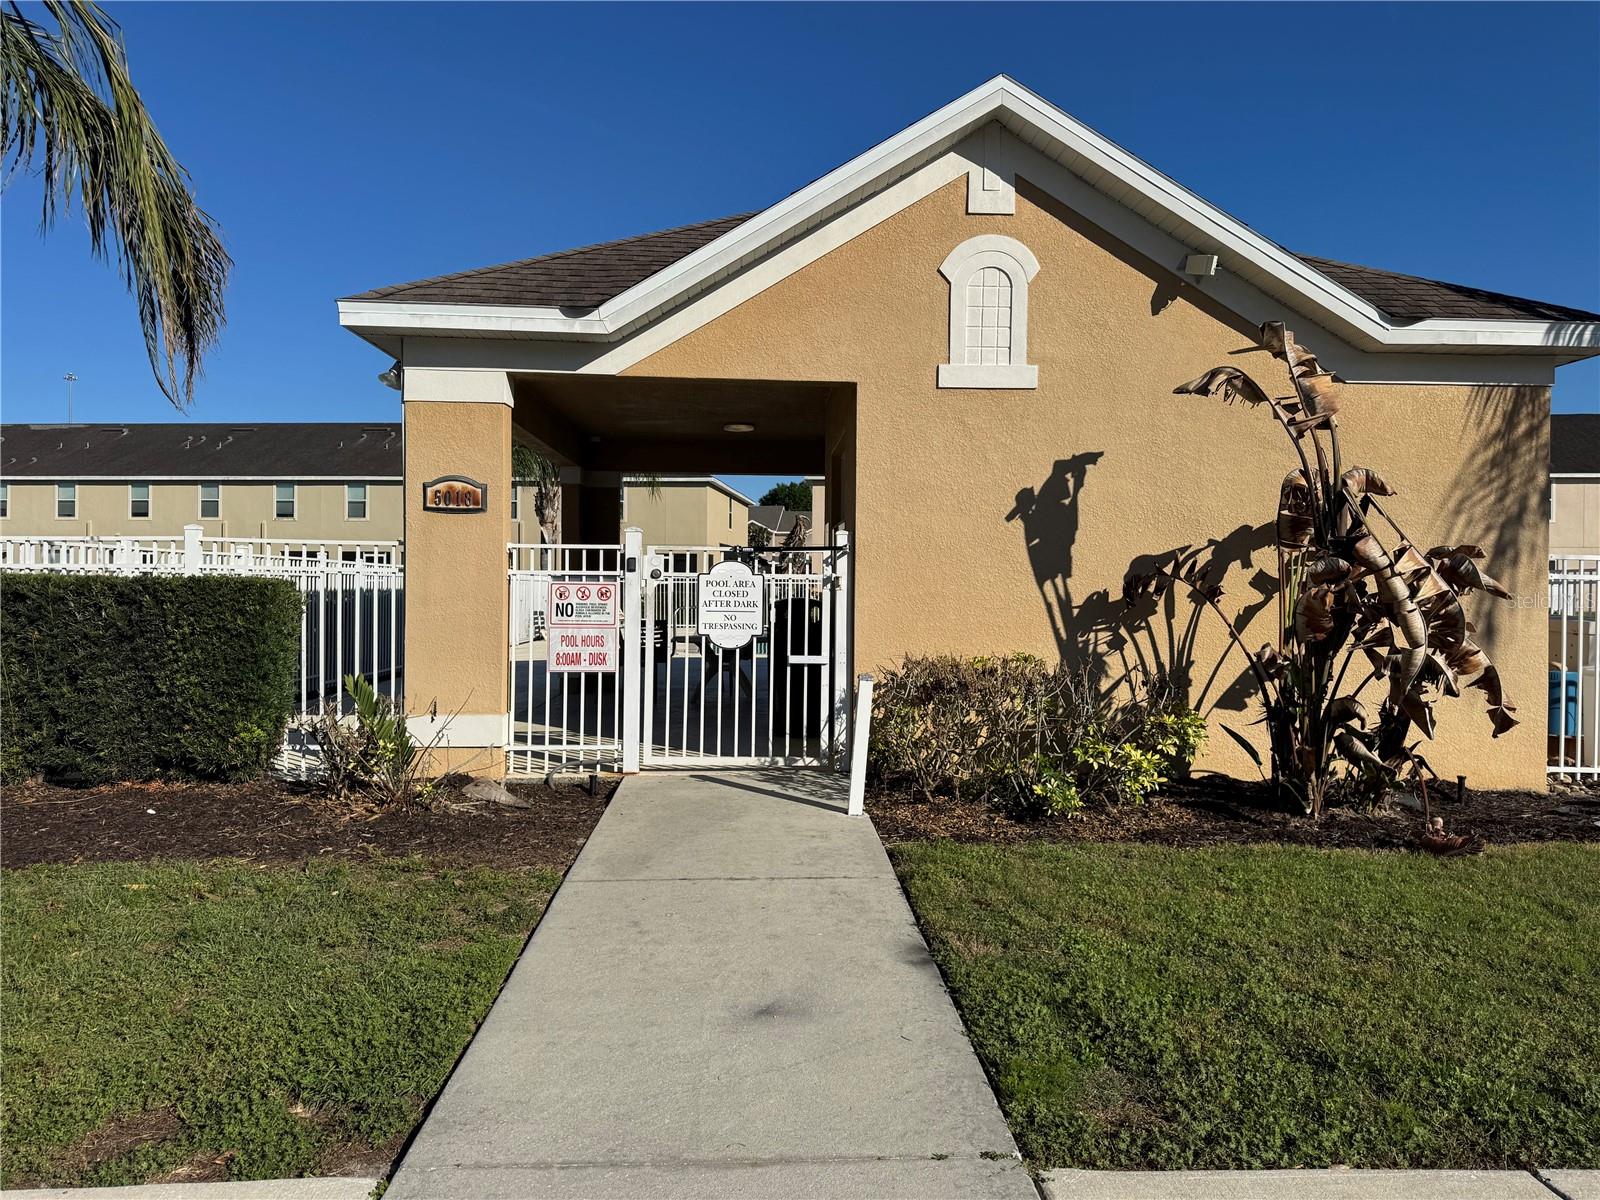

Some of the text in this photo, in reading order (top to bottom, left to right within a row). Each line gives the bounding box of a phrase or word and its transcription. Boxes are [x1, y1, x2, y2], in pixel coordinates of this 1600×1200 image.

[434, 489, 473, 507] 5018
[705, 580, 756, 588] POOL AREA
[712, 590, 749, 598] CLOSED
[702, 600, 759, 608] AFTER DARK
[555, 602, 574, 618] NO
[723, 614, 737, 622] NO
[702, 622, 758, 630] TRESPASSING
[560, 635, 605, 648] POOL HOURS
[555, 652, 582, 666] 8:00AM
[588, 652, 608, 666] DUSK
